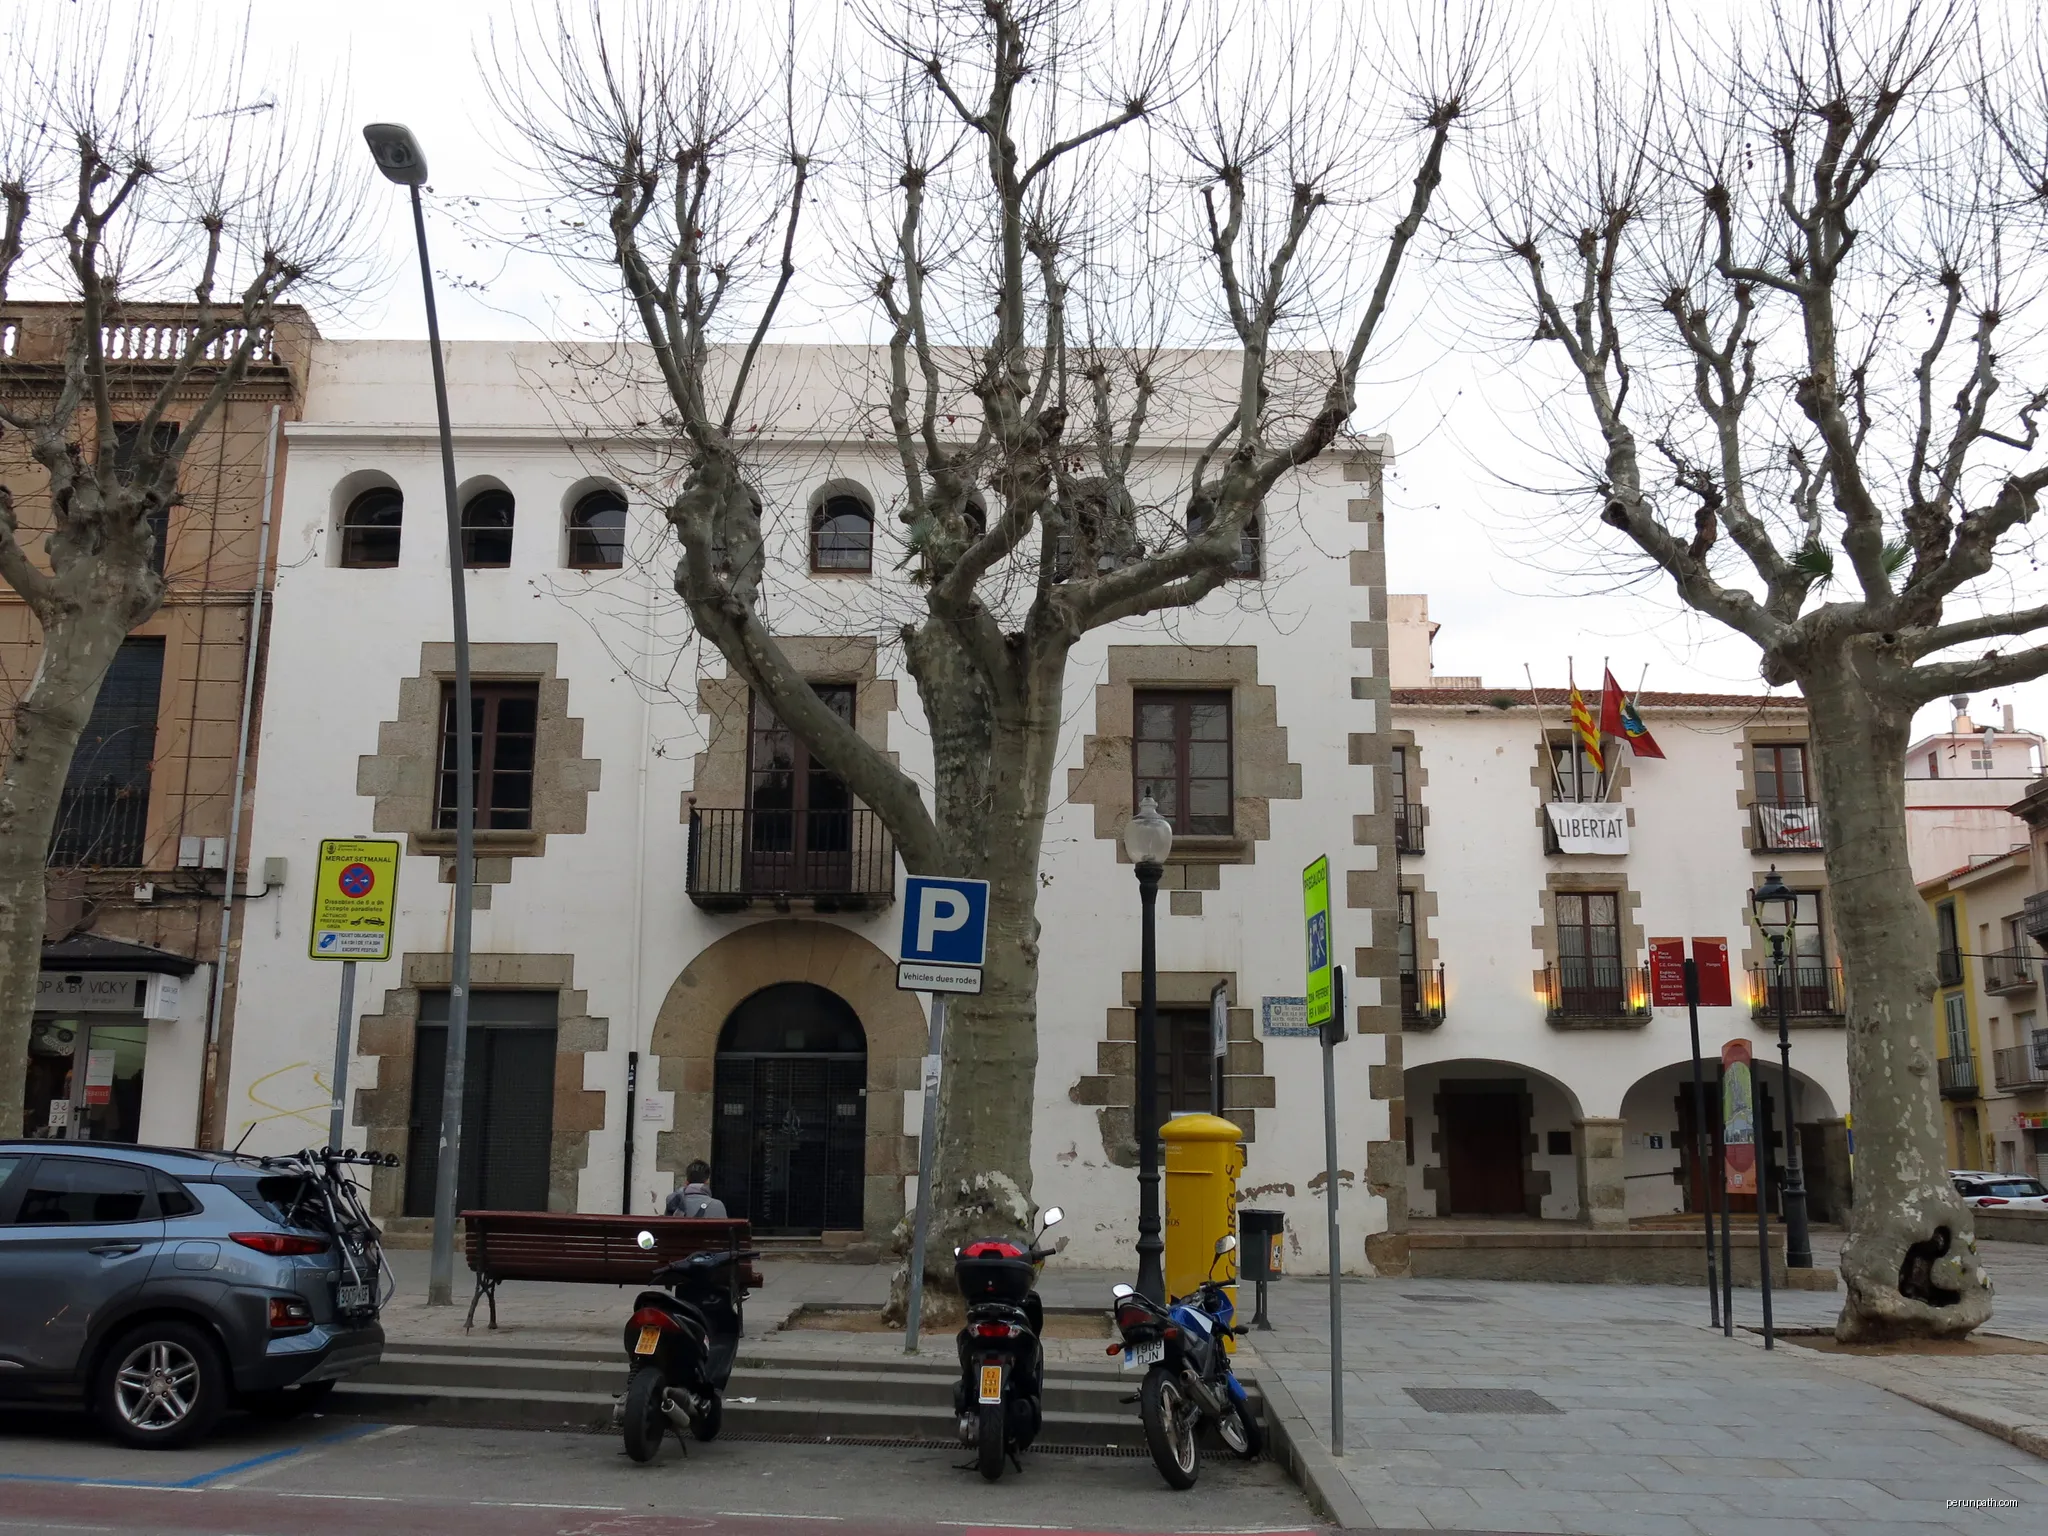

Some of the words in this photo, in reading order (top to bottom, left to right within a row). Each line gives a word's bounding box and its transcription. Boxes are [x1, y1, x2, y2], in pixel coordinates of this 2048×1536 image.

[916, 886, 970, 952] P
[56, 981, 64, 994] &
[69, 981, 84, 994] BY
[90, 981, 128, 994] VICKY
[904, 972, 934, 982] Vehicles
[936, 975, 954, 983] dues
[956, 976, 977, 985] rodes
[1226, 1164, 1236, 1281] COREUS
